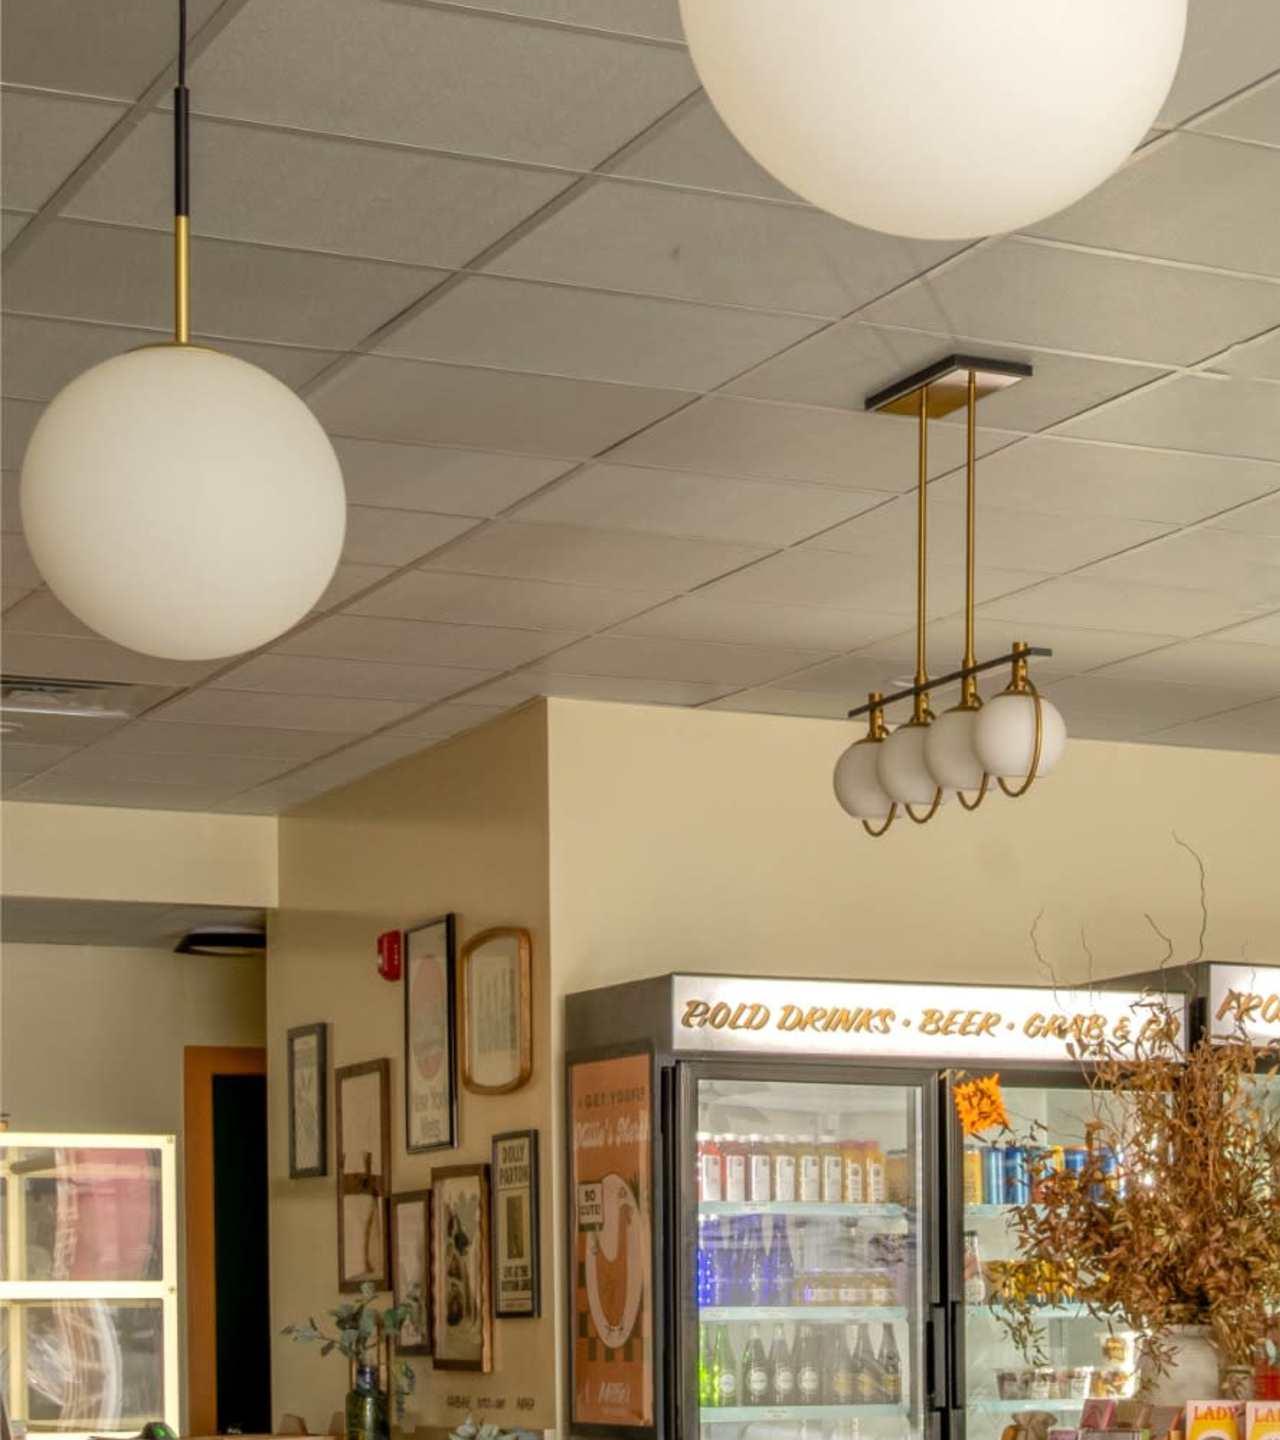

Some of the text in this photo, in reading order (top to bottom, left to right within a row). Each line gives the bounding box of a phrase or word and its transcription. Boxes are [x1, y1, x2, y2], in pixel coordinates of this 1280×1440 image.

[777, 1004, 895, 1035] DRINKS
[919, 1007, 1001, 1036] BEER
[1194, 1406, 1239, 1420] LADY
